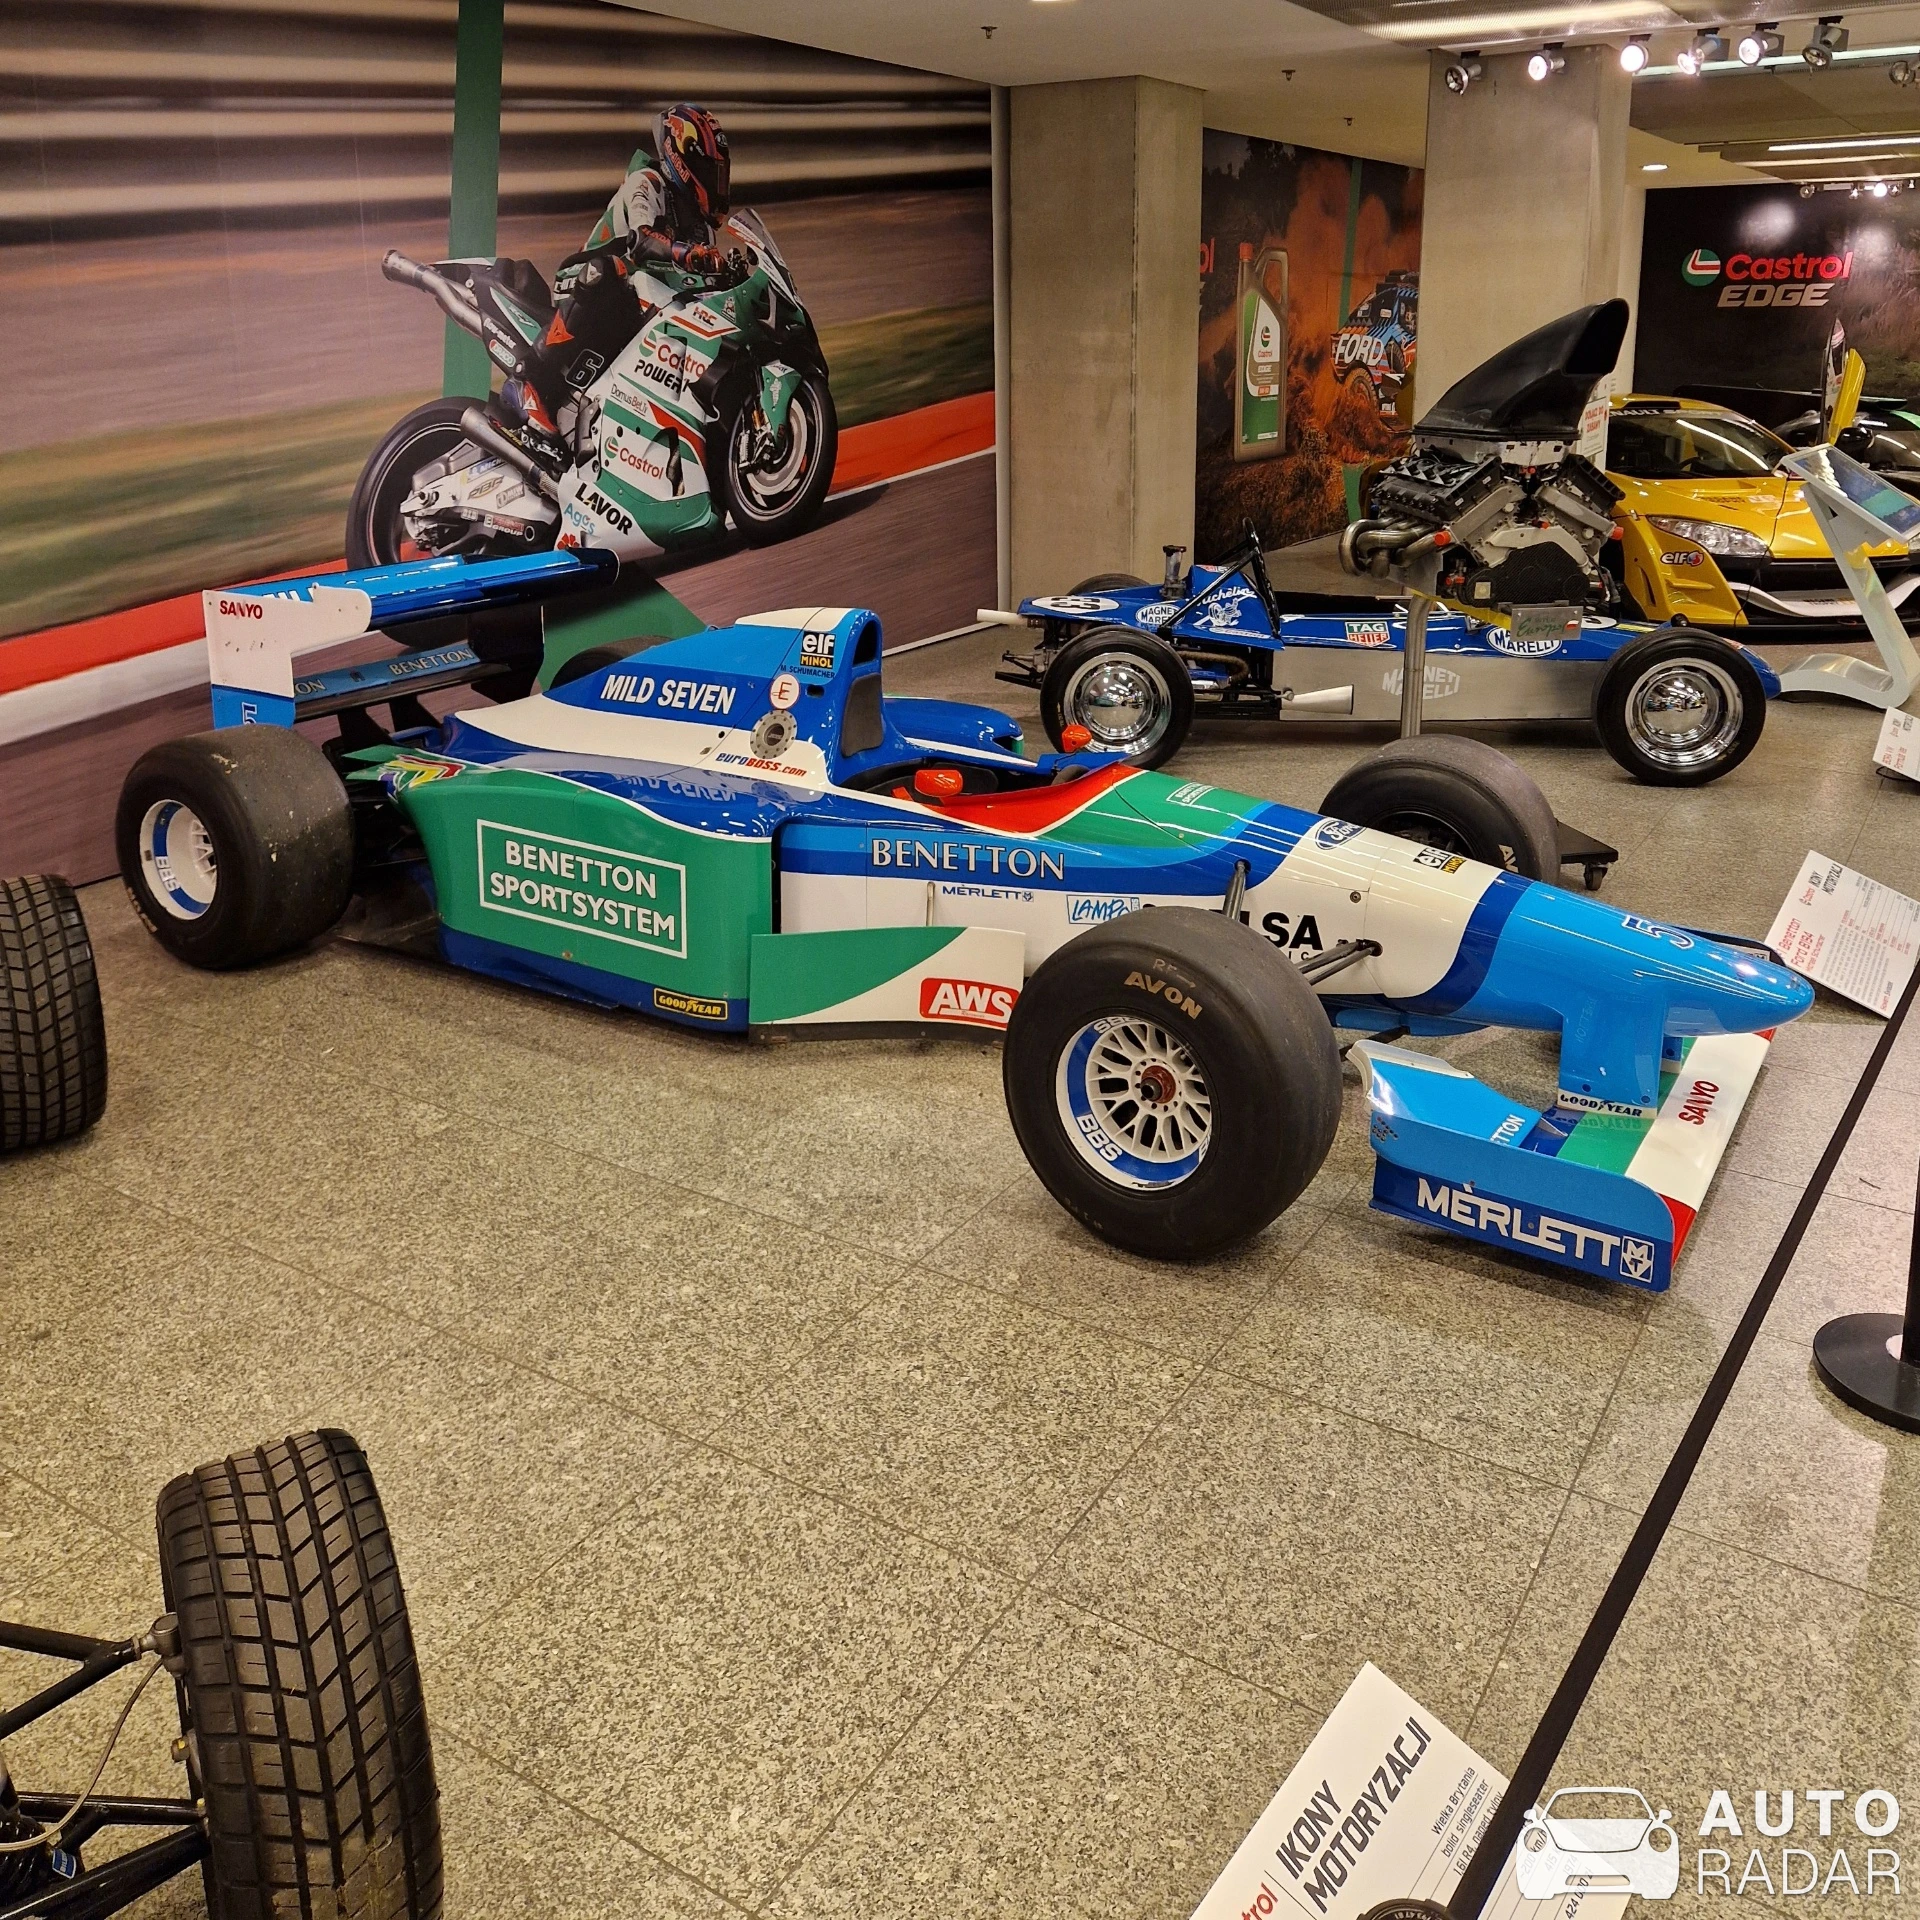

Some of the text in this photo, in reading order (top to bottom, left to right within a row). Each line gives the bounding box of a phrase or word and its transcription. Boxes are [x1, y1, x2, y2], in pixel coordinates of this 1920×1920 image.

[1725, 251, 1854, 281] Castrol
[1717, 283, 1836, 307] EDGE
[657, 344, 706, 378] Castro
[1335, 333, 1385, 367] FORD
[565, 348, 605, 389] 6
[619, 447, 665, 480] Castrol
[564, 502, 596, 536] Agos
[574, 482, 634, 536] LAVOR
[1661, 552, 1689, 564] elf
[219, 600, 263, 620] SANYO
[1197, 586, 1257, 607] ichelin
[802, 634, 835, 655] elf
[1350, 622, 1385, 633] TAG
[389, 648, 475, 675] BENETTON
[789, 665, 836, 679] SCHUMACHER
[801, 655, 833, 668] MINOL
[600, 674, 737, 716] MILD SEVEN
[778, 681, 793, 701] E
[715, 752, 808, 779] euroBOSS.com
[156, 856, 181, 891] BBS
[505, 840, 657, 899] BENETTON
[872, 838, 1065, 881] BENETTON
[490, 872, 676, 942] SPORTSYSTEM
[1621, 915, 1695, 949] 5
[928, 983, 1013, 1020] AWS
[1124, 971, 1203, 1020] AVON
[1678, 1080, 1720, 1126] SANYO
[1076, 1114, 1124, 1162] BBS
[1303, 1716, 1433, 1914] MOTORYZACJI
[1431, 1766, 1477, 1836] Wielka Brytania
[1275, 1779, 1342, 1880] IKONY
[1442, 1778, 1490, 1859] bolid singleseater
[1565, 1897, 1581, 1920] 424
